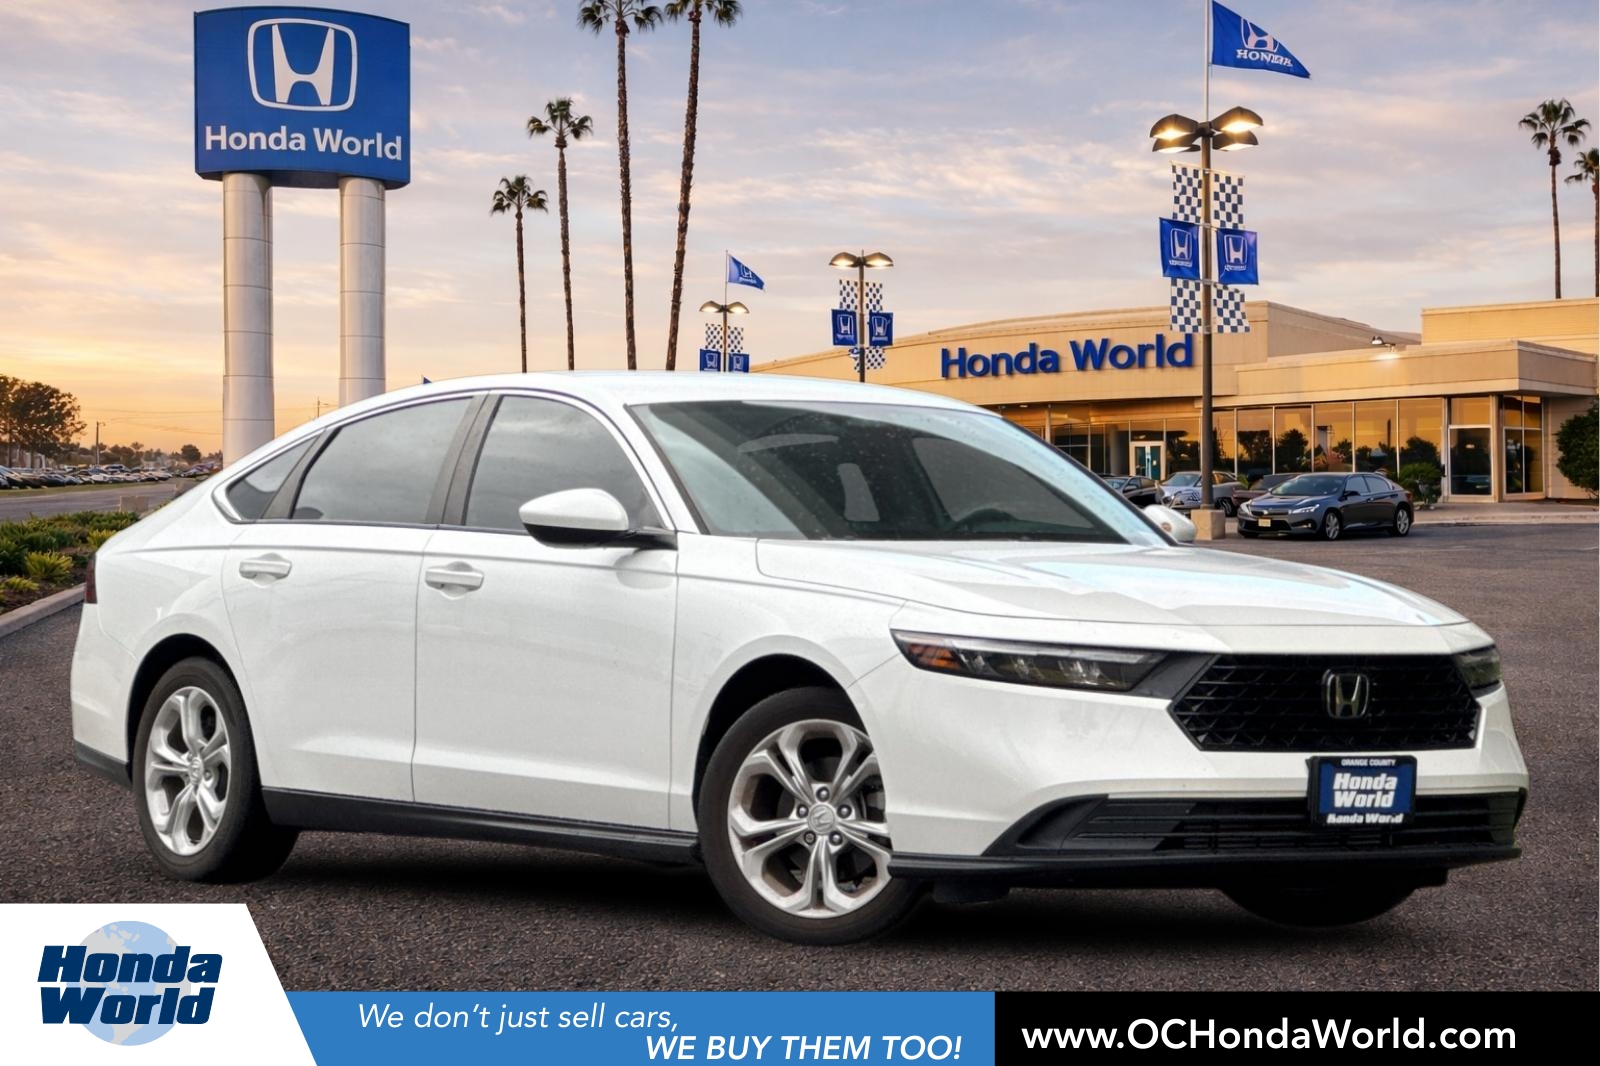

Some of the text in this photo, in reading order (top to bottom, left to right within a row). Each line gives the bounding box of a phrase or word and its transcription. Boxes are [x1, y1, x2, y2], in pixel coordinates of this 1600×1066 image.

[205, 125, 402, 161] Honda World
[941, 333, 1195, 378] Honda World
[1341, 758, 1396, 767] ORANGE COUNTY
[1333, 773, 1398, 790] Honda
[1334, 791, 1395, 808] World
